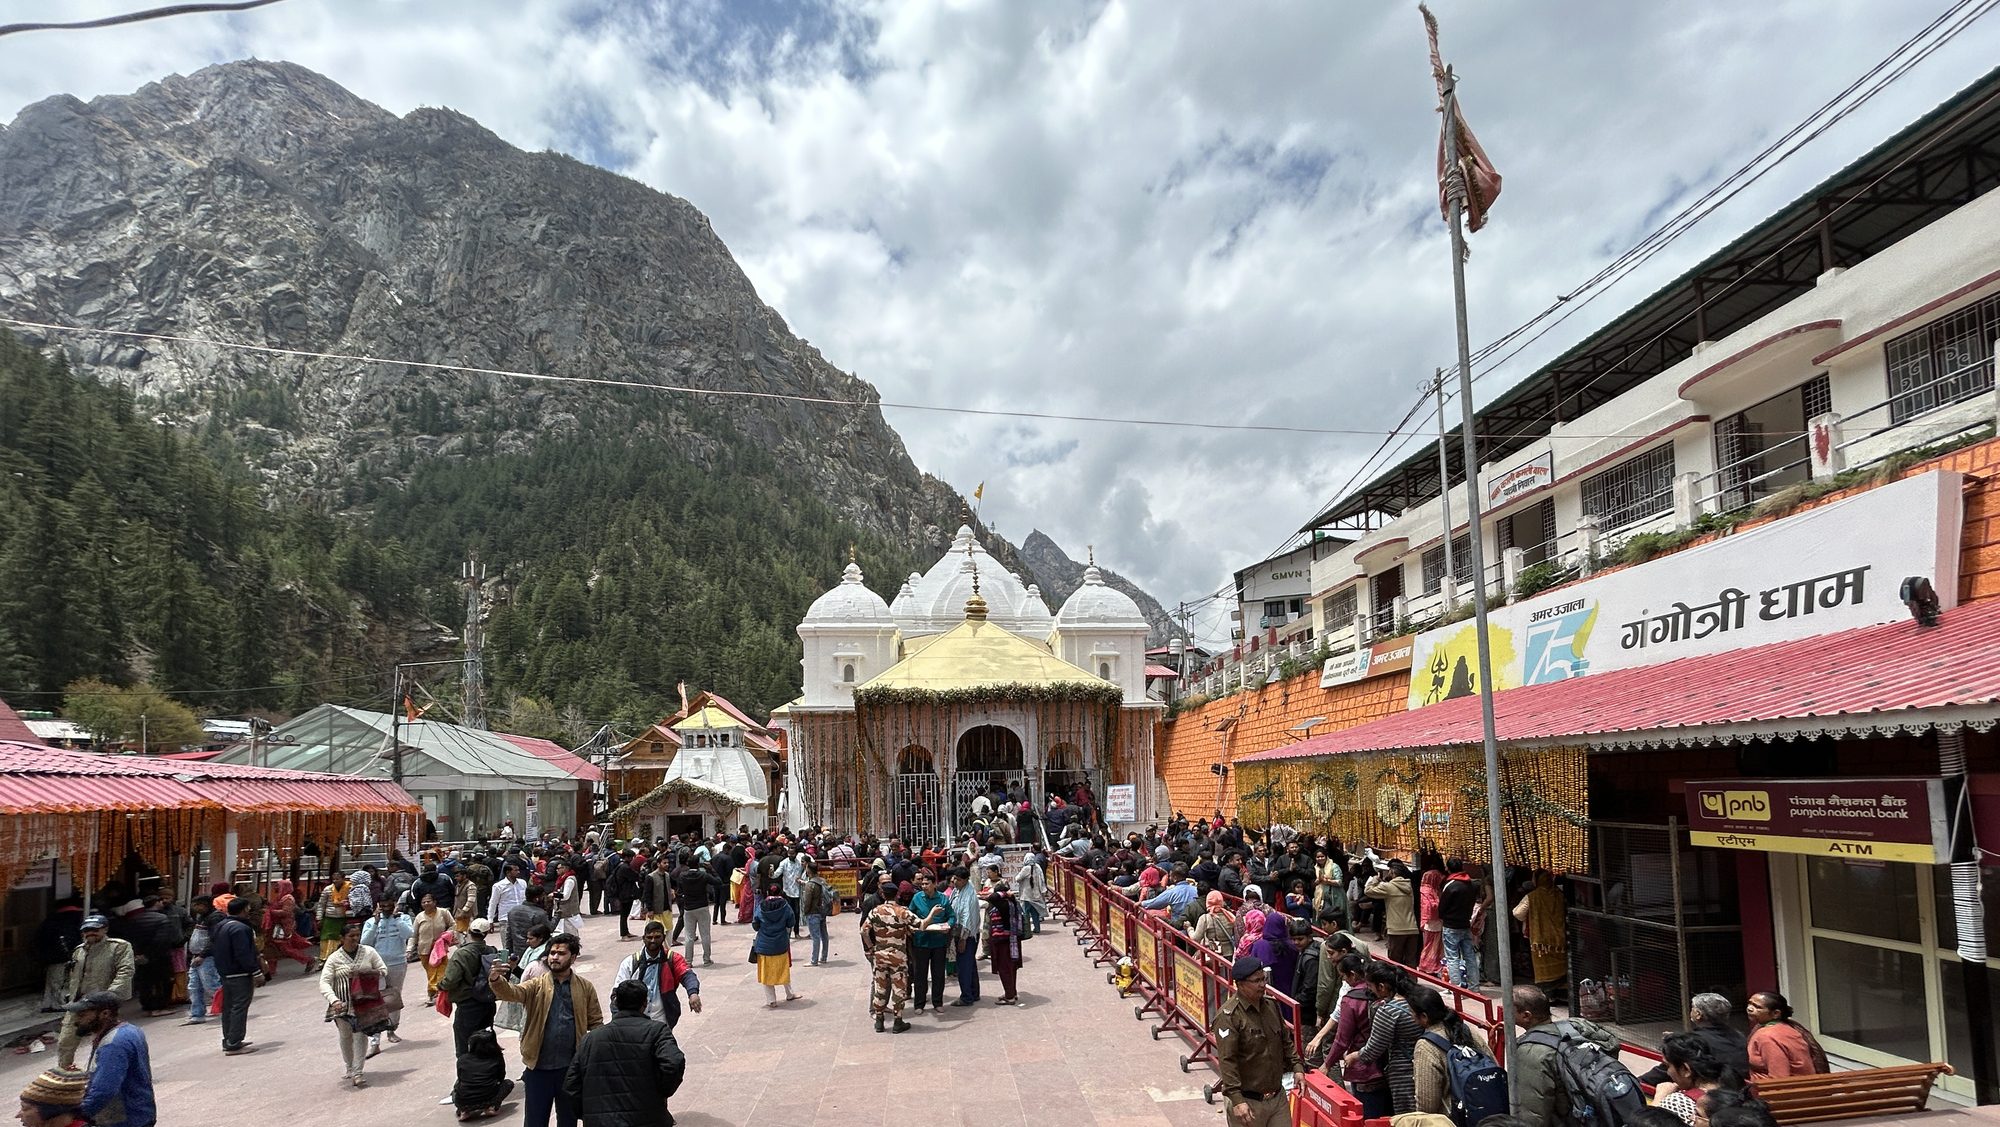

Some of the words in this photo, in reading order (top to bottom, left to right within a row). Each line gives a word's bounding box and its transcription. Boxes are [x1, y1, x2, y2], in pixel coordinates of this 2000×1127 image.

[1517, 475, 1536, 490] निवास
[1271, 570, 1302, 580] GMVN
[1621, 587, 1750, 649] गंगोत्री
[1759, 565, 1871, 620] धाम
[1729, 794, 1766, 816] pnb
[1789, 795, 1825, 806] पंजाब
[1828, 794, 1877, 806] नैशनल
[1881, 794, 1907, 807] बैंक
[1790, 807, 1826, 818] punjab
[1828, 808, 1876, 818] national
[1877, 808, 1909, 819] bank
[1717, 834, 1756, 847] एटीएम
[1829, 842, 1873, 855] ATM
